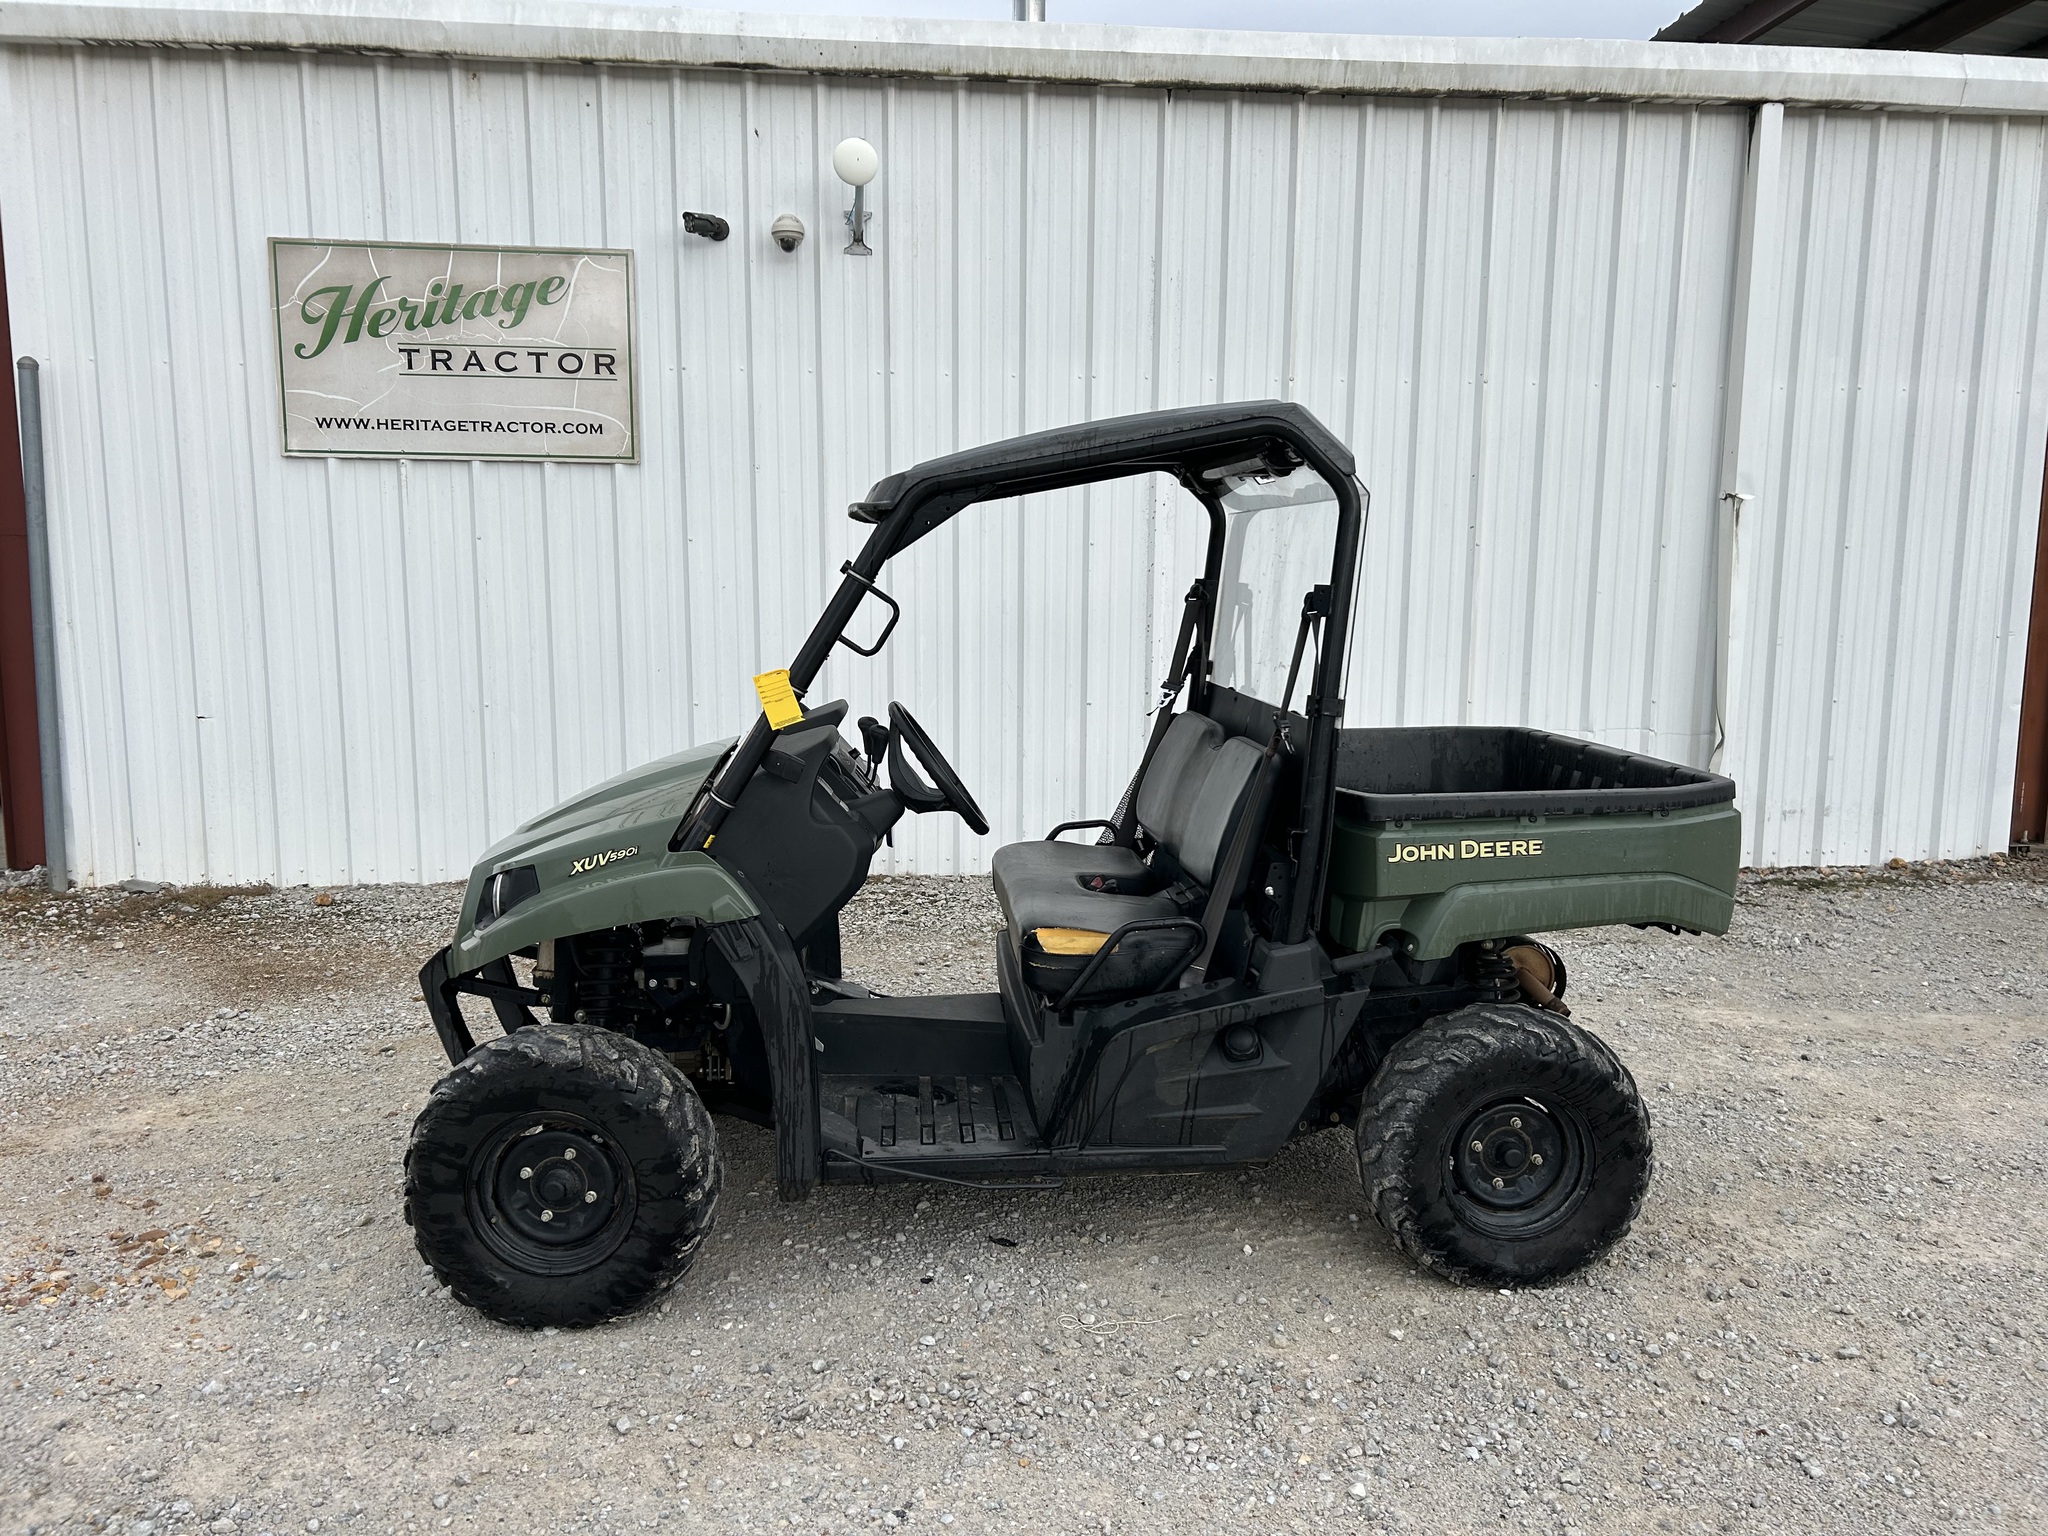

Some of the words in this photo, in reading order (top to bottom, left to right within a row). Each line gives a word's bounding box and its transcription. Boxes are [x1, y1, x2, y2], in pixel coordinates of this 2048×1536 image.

[294, 275, 571, 360] Heritage
[399, 348, 616, 375] TRACTOR
[315, 416, 604, 435] WWW.HERITAGETRACTOR.COM
[1387, 843, 1455, 863] JOHN
[1460, 840, 1543, 859] DEERE
